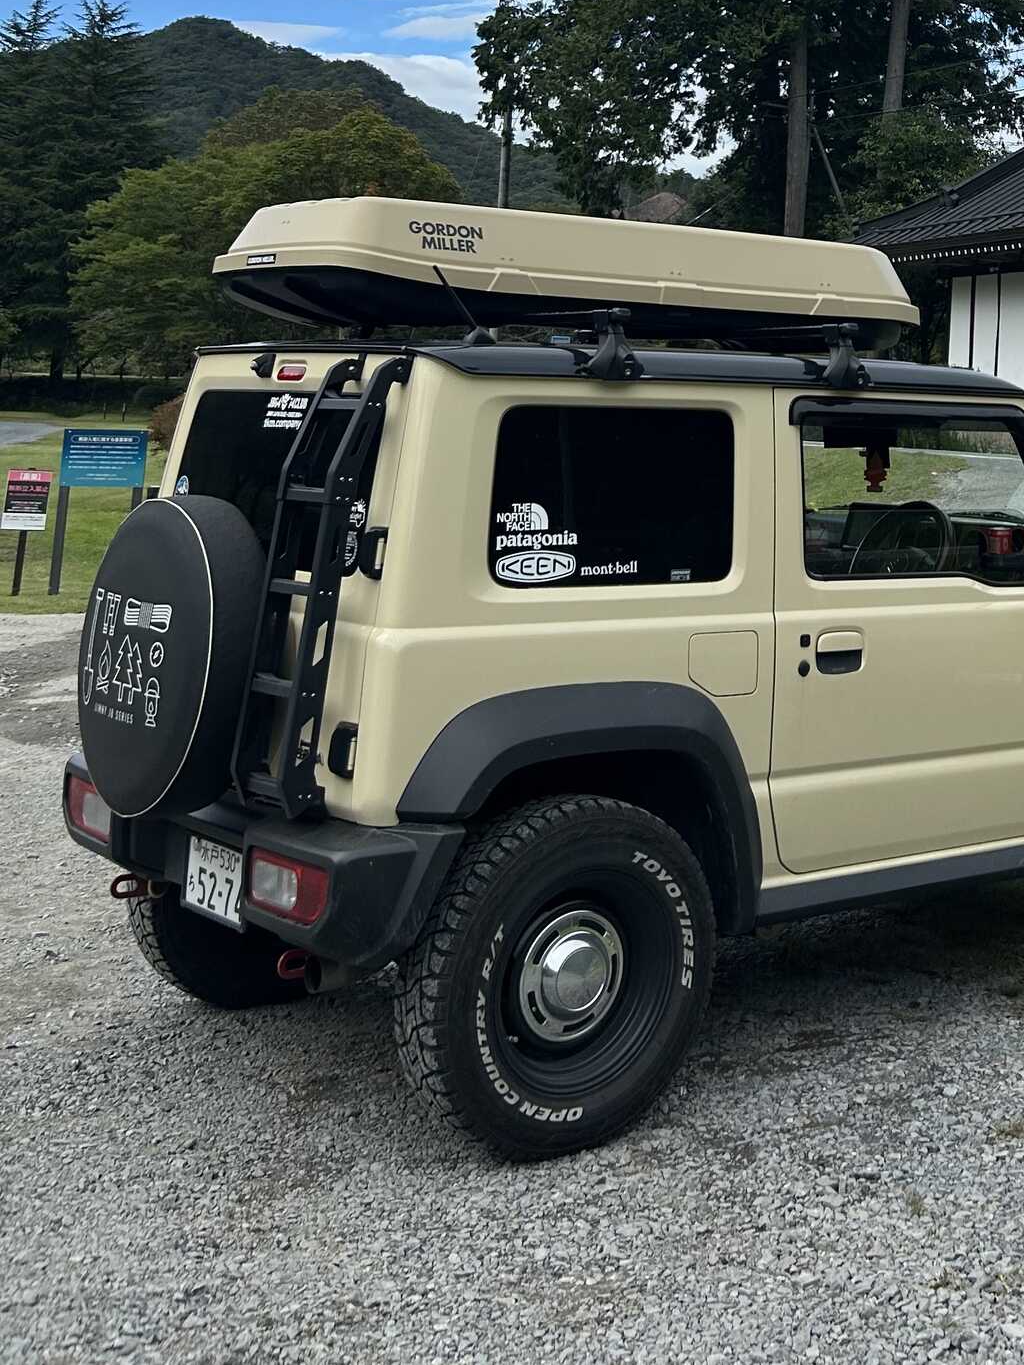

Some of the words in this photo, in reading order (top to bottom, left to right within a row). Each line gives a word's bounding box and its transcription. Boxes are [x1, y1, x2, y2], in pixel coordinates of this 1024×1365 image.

[409, 221, 483, 239] GORDON
[422, 236, 476, 254] MILLER
[512, 503, 531, 513] THE
[496, 513, 531, 523] NORTH
[506, 521, 531, 532] FACE
[496, 530, 578, 550] patagonia
[501, 557, 571, 576] KEEN
[632, 850, 682, 898] TOYO
[676, 900, 695, 990] TIRES
[476, 988, 519, 1106] COUNTRY
[519, 1100, 584, 1122] OPEN
